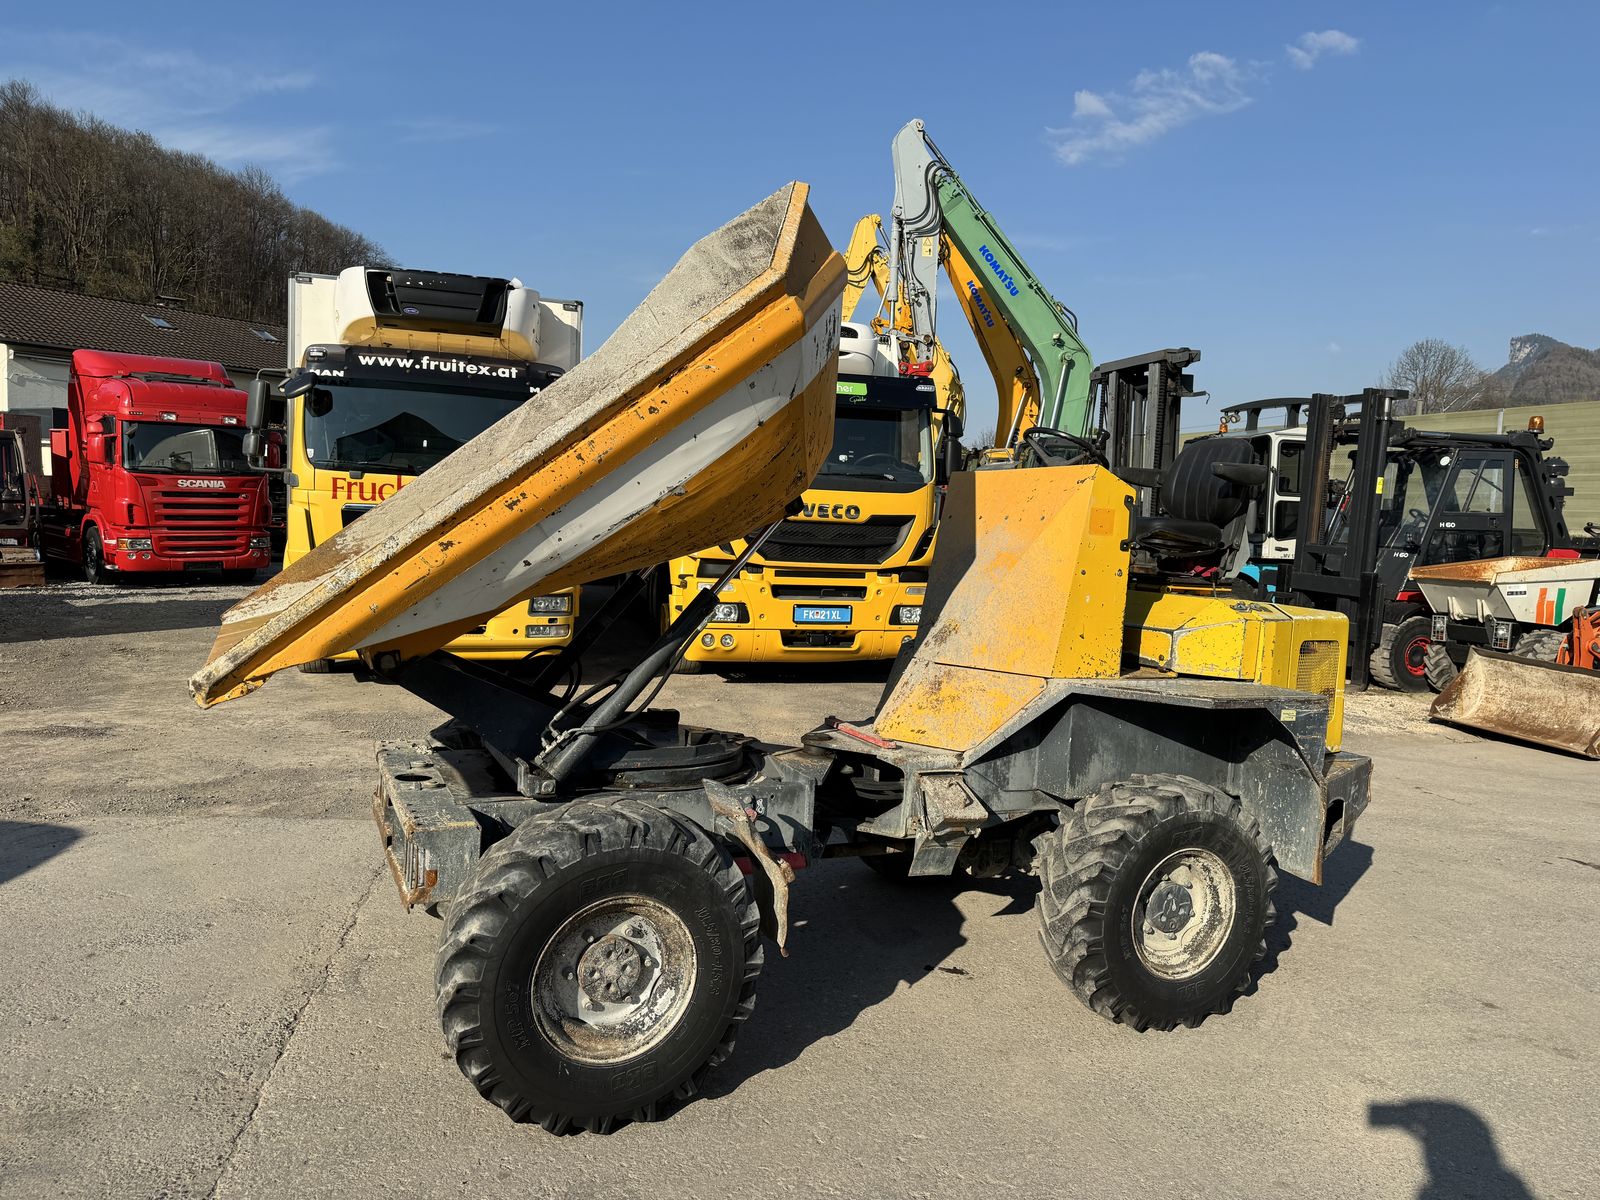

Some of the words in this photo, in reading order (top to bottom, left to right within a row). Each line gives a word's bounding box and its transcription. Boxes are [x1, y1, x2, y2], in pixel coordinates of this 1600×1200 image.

[979, 244, 1019, 297] KOMATSU
[966, 280, 995, 328] KOMATSU
[357, 354, 518, 380] www.fruitex.at
[836, 384, 854, 393] her
[177, 479, 226, 489] SCANIA
[802, 503, 861, 520] VECO
